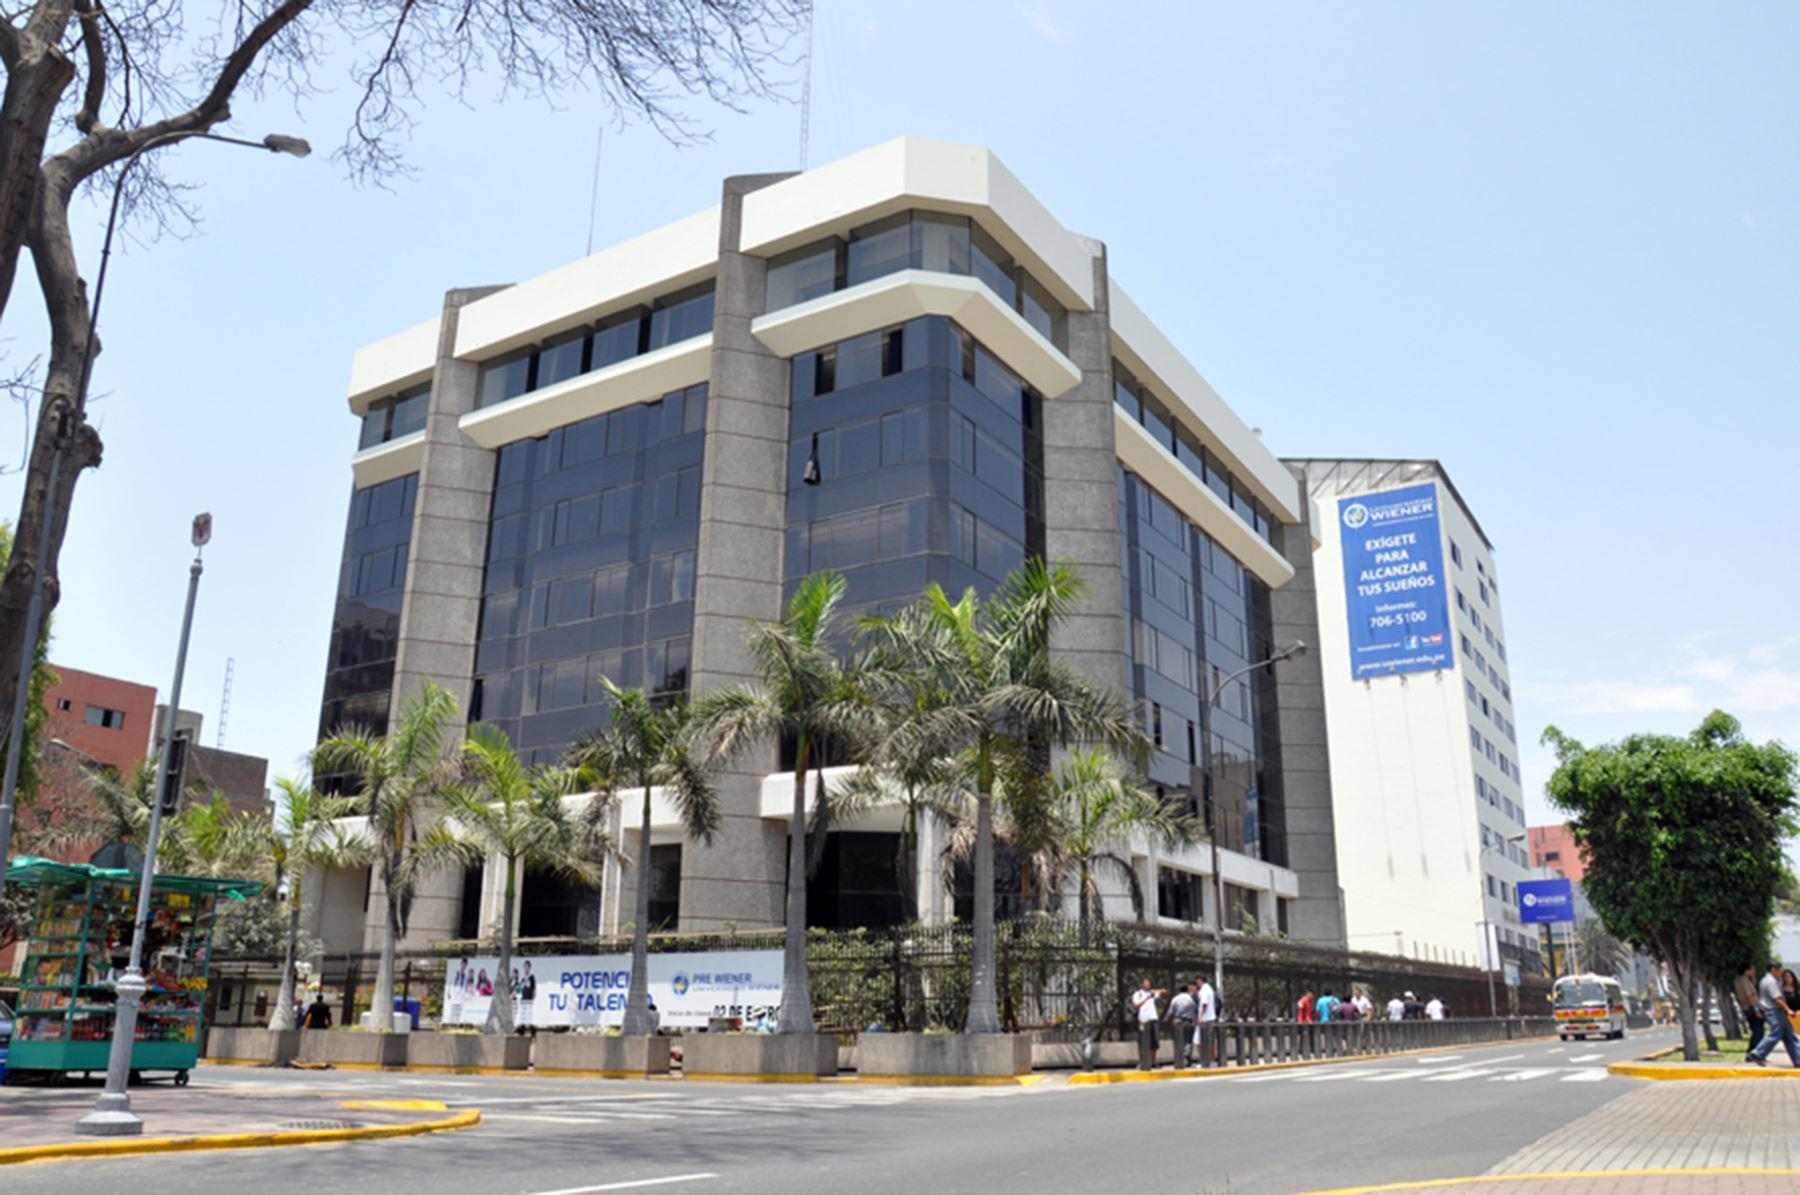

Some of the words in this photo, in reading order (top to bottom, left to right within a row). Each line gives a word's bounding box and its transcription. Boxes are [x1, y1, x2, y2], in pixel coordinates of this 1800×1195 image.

[1371, 503, 1434, 521] WIENER
[1365, 532, 1416, 551] EXÍGETE
[1375, 549, 1409, 564] PARA
[1360, 560, 1427, 581] ALCANZAR
[1357, 583, 1382, 597] TUS
[1384, 574, 1435, 593] SUEÑOS
[1370, 610, 1427, 628] 706-5100
[560, 971, 631, 990] POTENCI
[692, 973, 711, 985] PRE
[714, 972, 753, 984] WIENER
[549, 993, 568, 1011] TU
